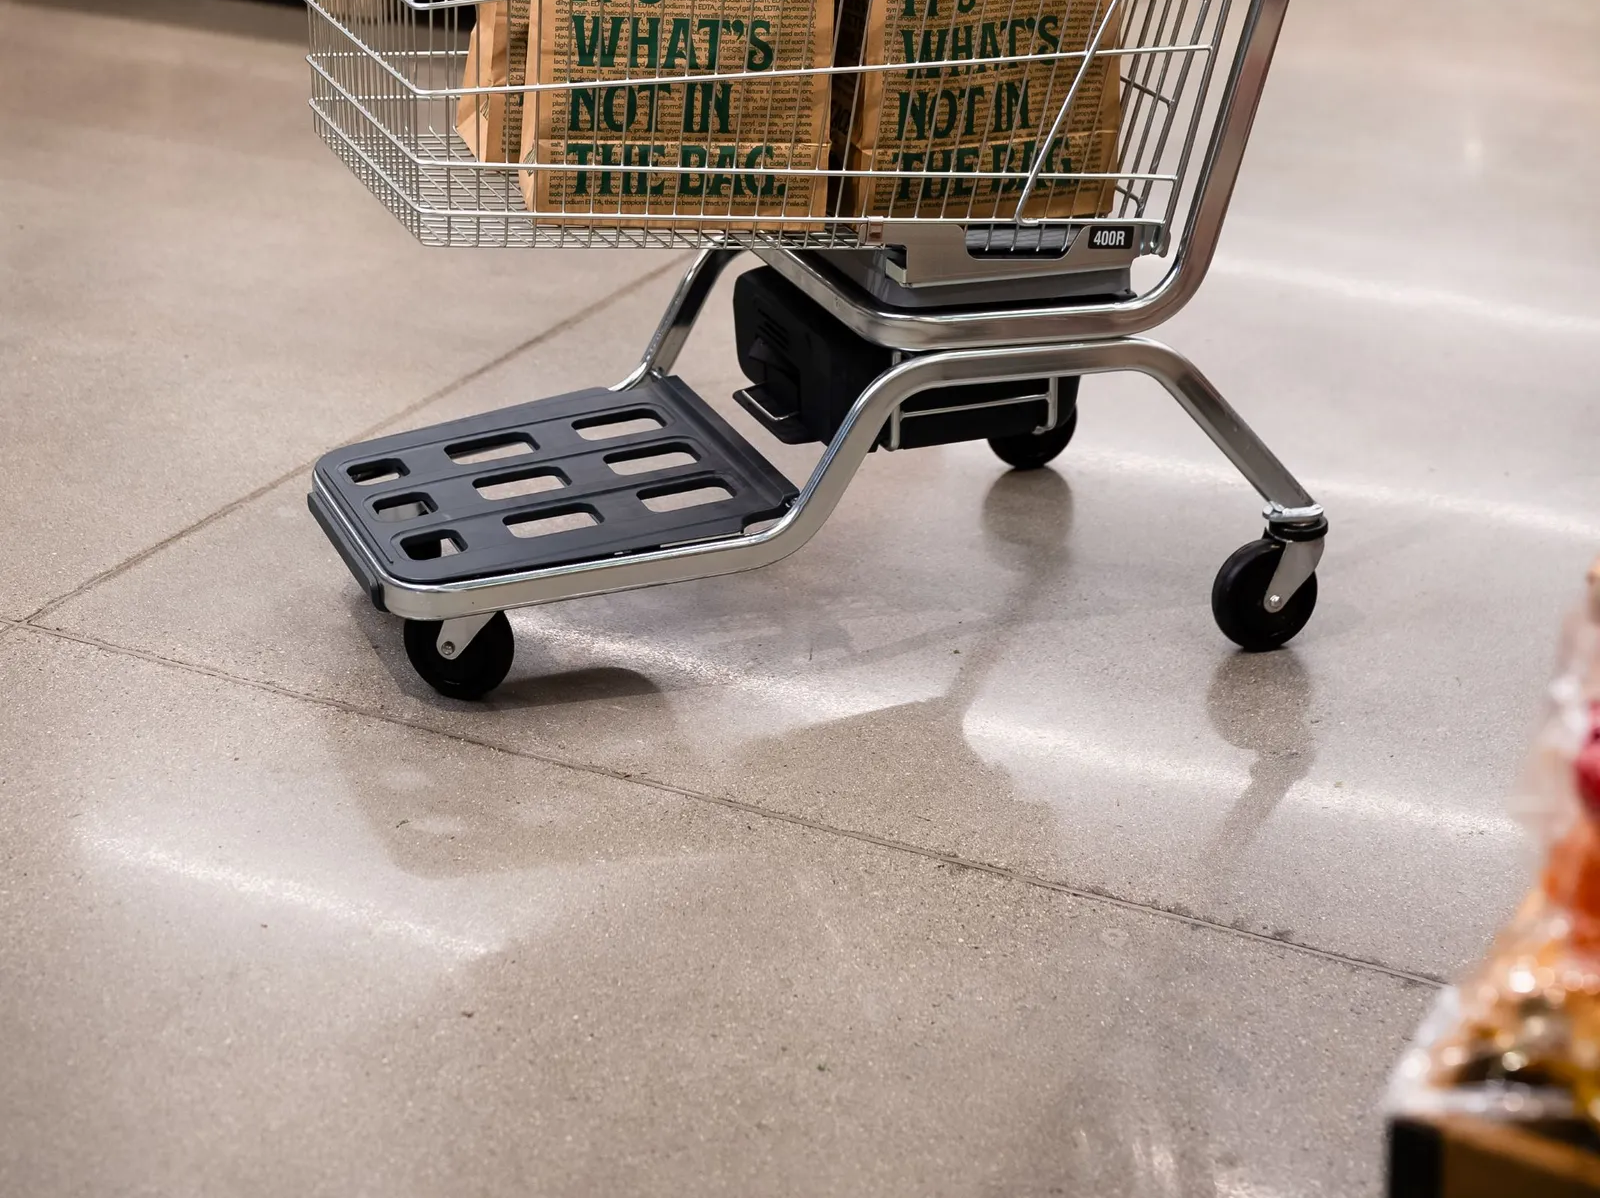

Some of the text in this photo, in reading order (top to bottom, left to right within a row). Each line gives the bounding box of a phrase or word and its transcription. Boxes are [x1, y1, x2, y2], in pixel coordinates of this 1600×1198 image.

[571, 15, 774, 71] WHAT'S
[900, 15, 1060, 78] WHAT'S
[570, 84, 671, 133] NOT
[683, 83, 733, 133] IN
[897, 87, 984, 140] NOT
[992, 79, 1031, 133] IN
[567, 144, 665, 194] THE
[678, 145, 786, 195] BAG.
[892, 148, 978, 199] THE
[1094, 231, 1125, 246] 400R
